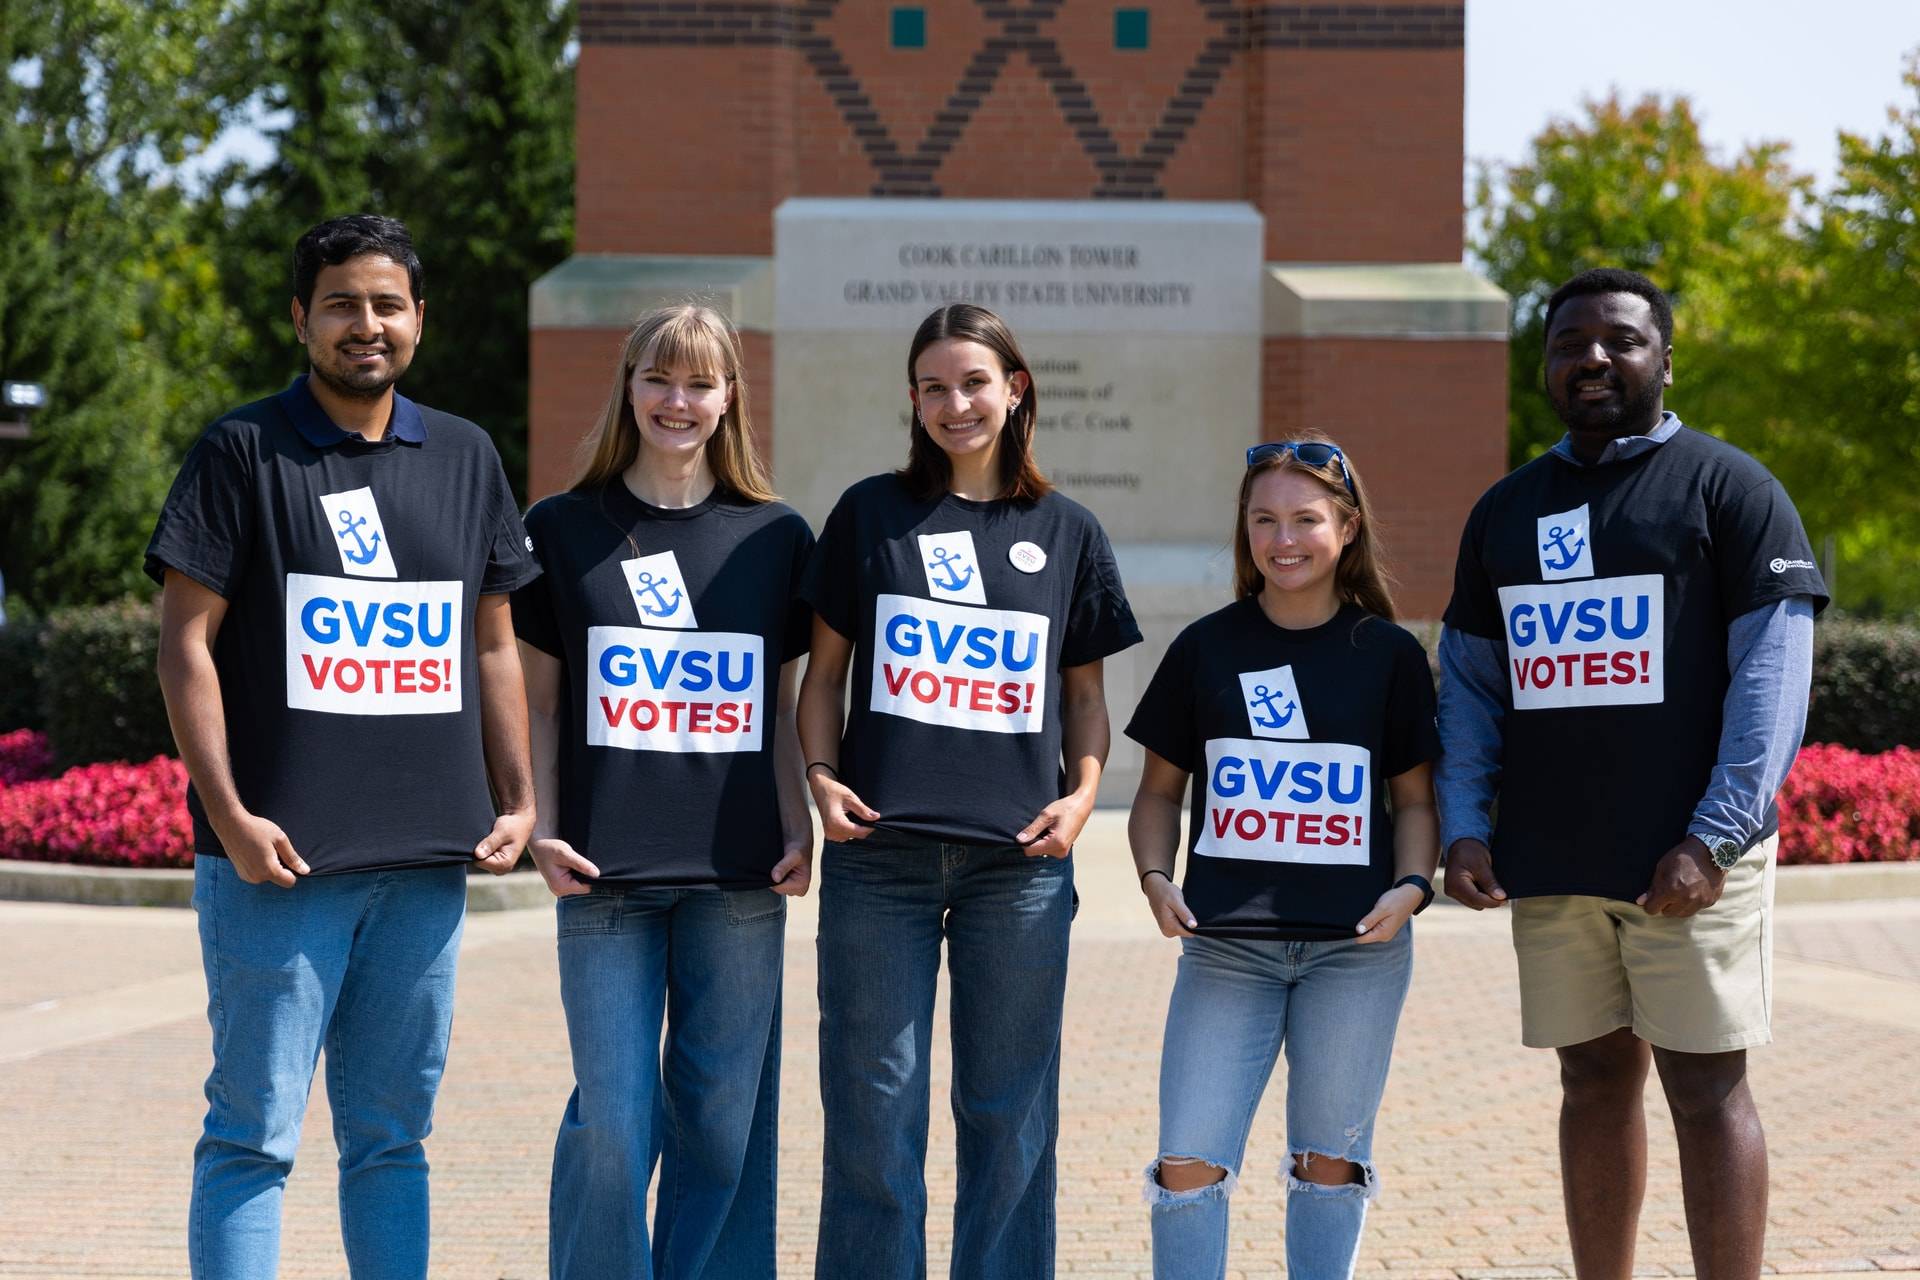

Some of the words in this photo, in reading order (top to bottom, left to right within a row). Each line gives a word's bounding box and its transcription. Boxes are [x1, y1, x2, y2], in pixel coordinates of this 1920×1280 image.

[898, 243, 957, 268] COOK
[960, 243, 1064, 268] CARILLON
[1069, 243, 1140, 269] TOWER
[844, 279, 920, 304] GRAND
[920, 280, 1002, 304] VALLEY
[1005, 281, 1068, 306] STATE
[1072, 281, 1192, 307] UNIVERSITY
[301, 596, 452, 648] GVSU
[885, 613, 1039, 672] GVSU
[1509, 594, 1649, 648] GVSU
[301, 653, 452, 694] VOTES!
[598, 644, 754, 693] GVSU
[882, 663, 1036, 715] VOTES!
[1513, 650, 1650, 691] VOTES!
[599, 696, 753, 734] VOTES!
[1212, 756, 1364, 805] GVSU
[1212, 807, 1363, 847] VOTES!
